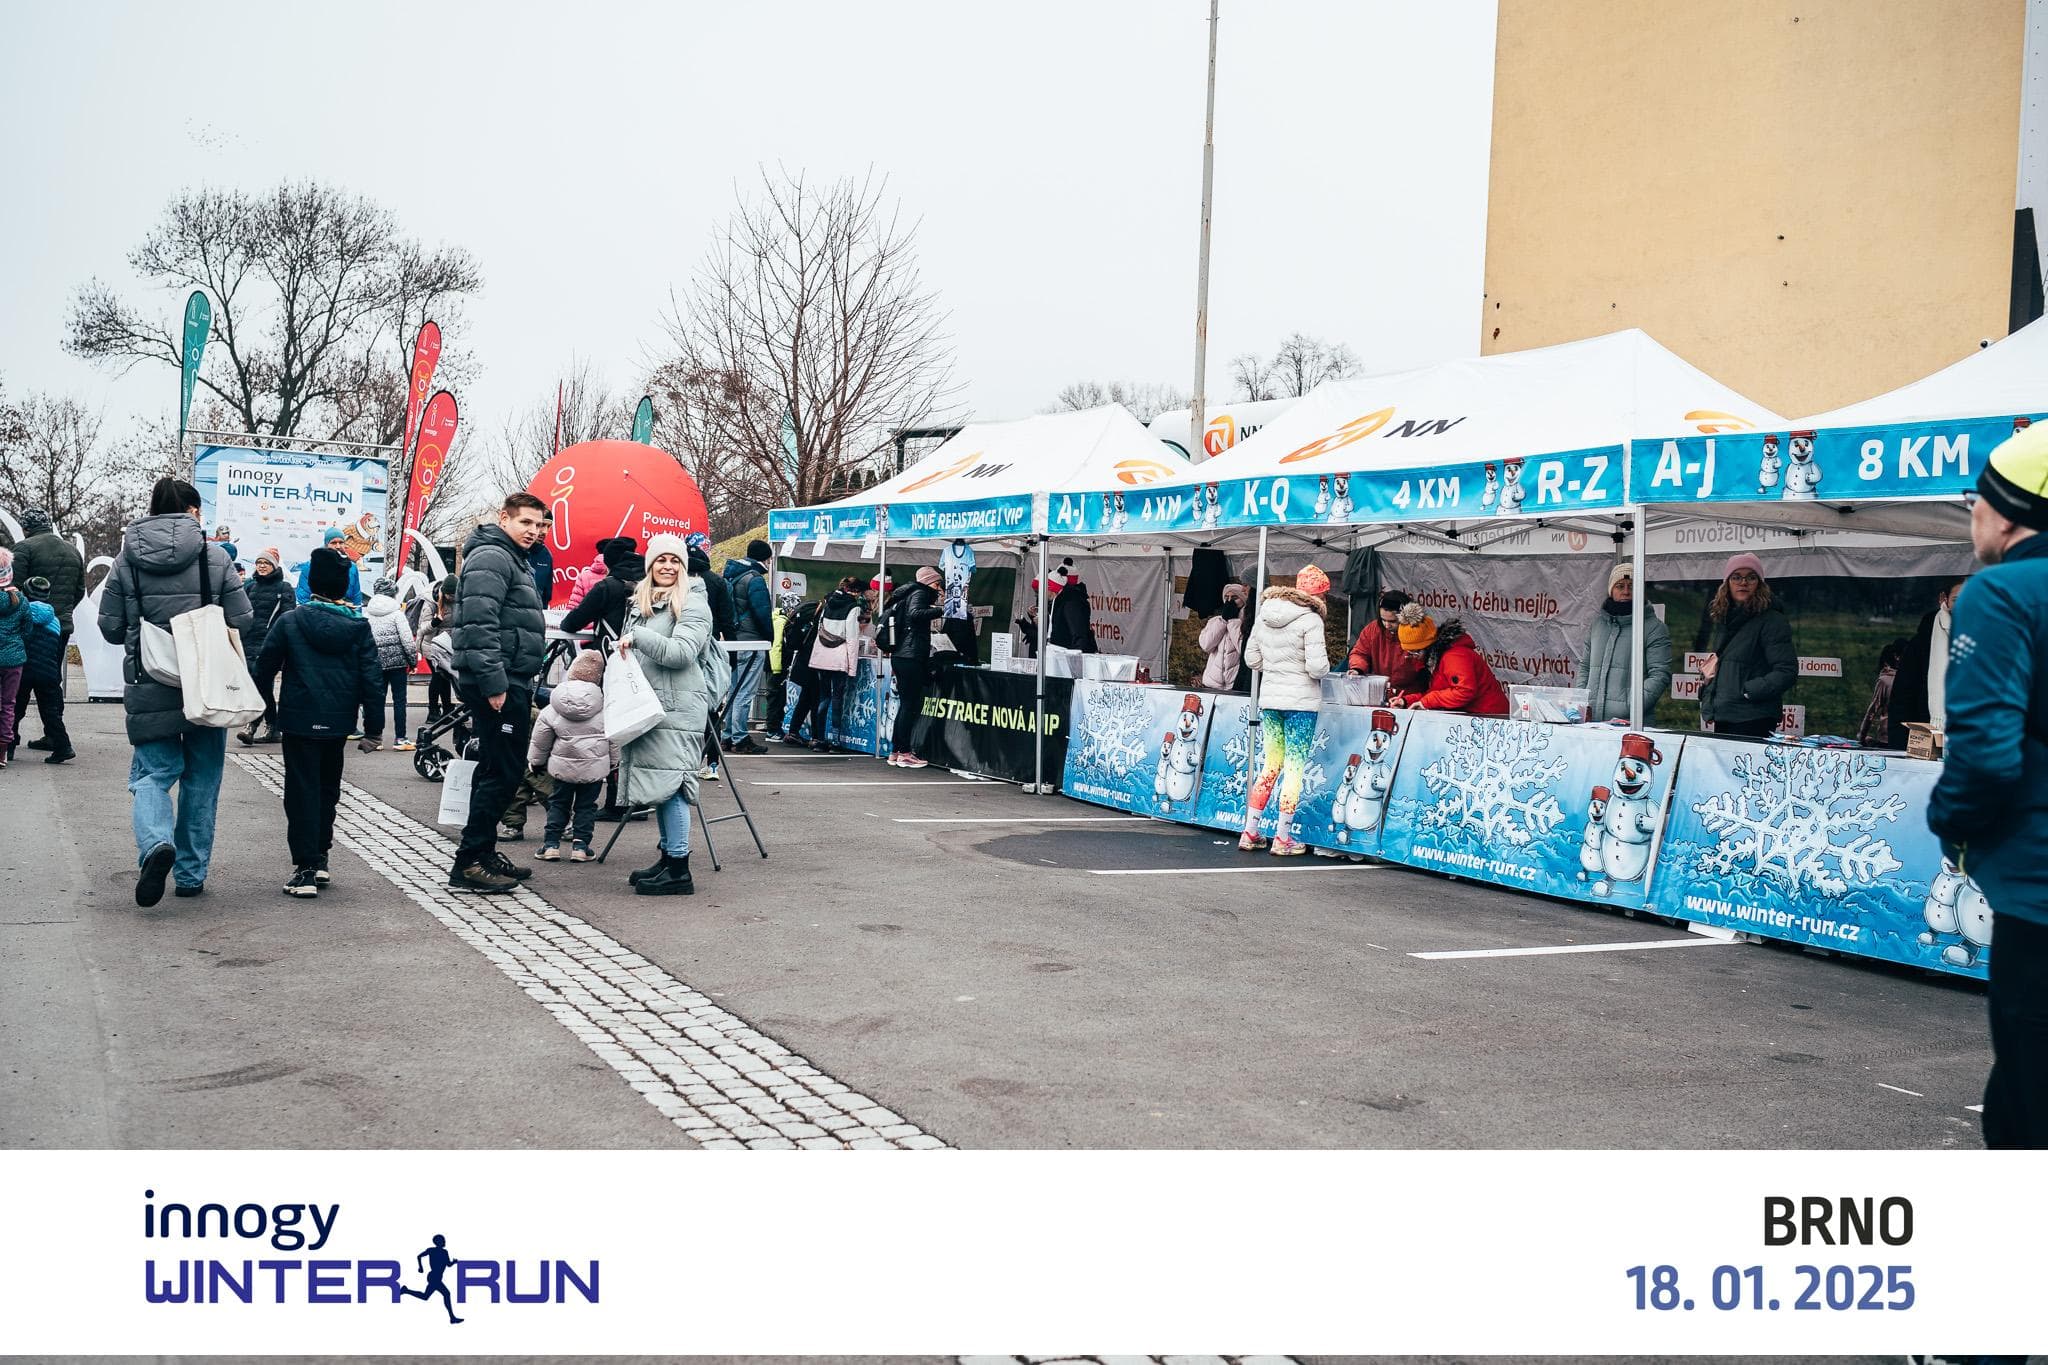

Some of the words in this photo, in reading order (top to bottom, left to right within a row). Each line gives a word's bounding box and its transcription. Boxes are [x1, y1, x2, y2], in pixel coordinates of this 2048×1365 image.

[1651, 438, 1717, 499] A-J
[1857, 439, 1884, 481] 8
[1898, 433, 1971, 479] KM
[228, 465, 283, 485] innogy
[1536, 455, 1608, 505] R-Z
[228, 483, 299, 500] WINTER
[313, 490, 353, 504] RUN
[1242, 478, 1290, 523] K-Q
[1391, 480, 1411, 509] 4
[642, 511, 691, 530] Powered
[911, 509, 936, 530] NOVÉ
[937, 509, 996, 530] REGISTRACE
[1003, 506, 1024, 525] VIP
[1056, 493, 1085, 532] A-J
[1141, 497, 1152, 522] 4
[1106, 591, 1132, 613] vám
[1417, 590, 1462, 613] dobře,
[1473, 590, 1509, 613] běhu
[1521, 648, 1576, 680] vyhrát,
[1806, 659, 1839, 674] doma,
[920, 696, 990, 725] REGISTRACE
[991, 705, 1026, 732] NOVÁ
[1028, 711, 1036, 733] A
[1043, 713, 1060, 736] IP
[1073, 781, 1131, 804] www.winter-run.cz
[1412, 844, 1537, 880] www.winter-run.cz
[1686, 894, 1861, 942] www.winter-run.cz
